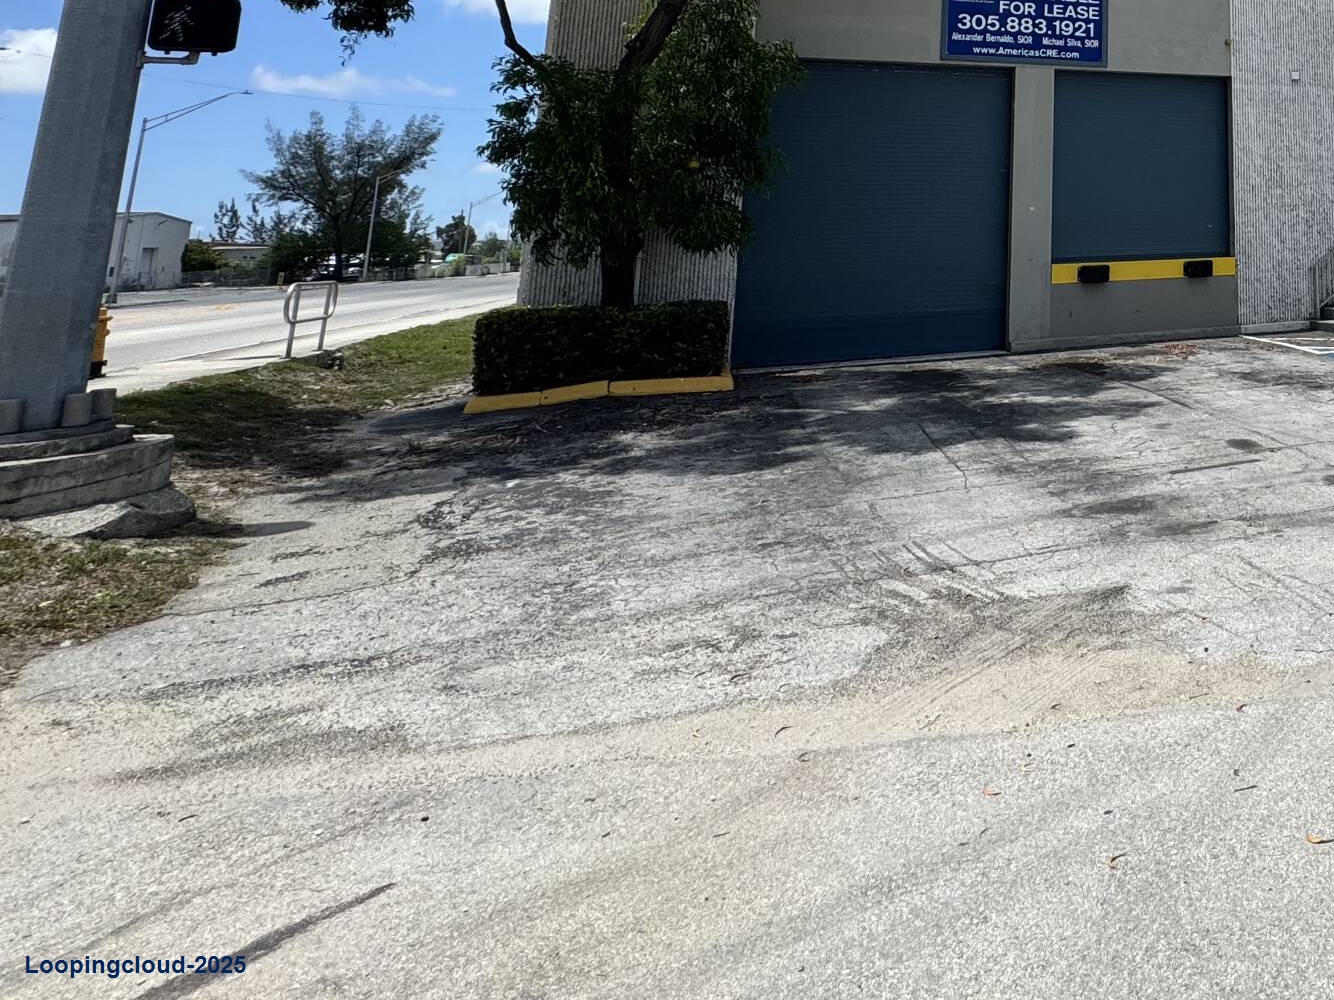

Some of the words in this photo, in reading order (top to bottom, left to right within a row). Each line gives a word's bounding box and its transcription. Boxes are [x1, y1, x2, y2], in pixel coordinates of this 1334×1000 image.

[999, 0, 1036, 16] FOR
[1044, 3, 1100, 20] LEASE
[957, 13, 1095, 38] 305.883.1921
[951, 31, 984, 42] Alexander
[1042, 36, 1065, 46] Michael
[972, 46, 1080, 59] www.AmericasCRE.com
